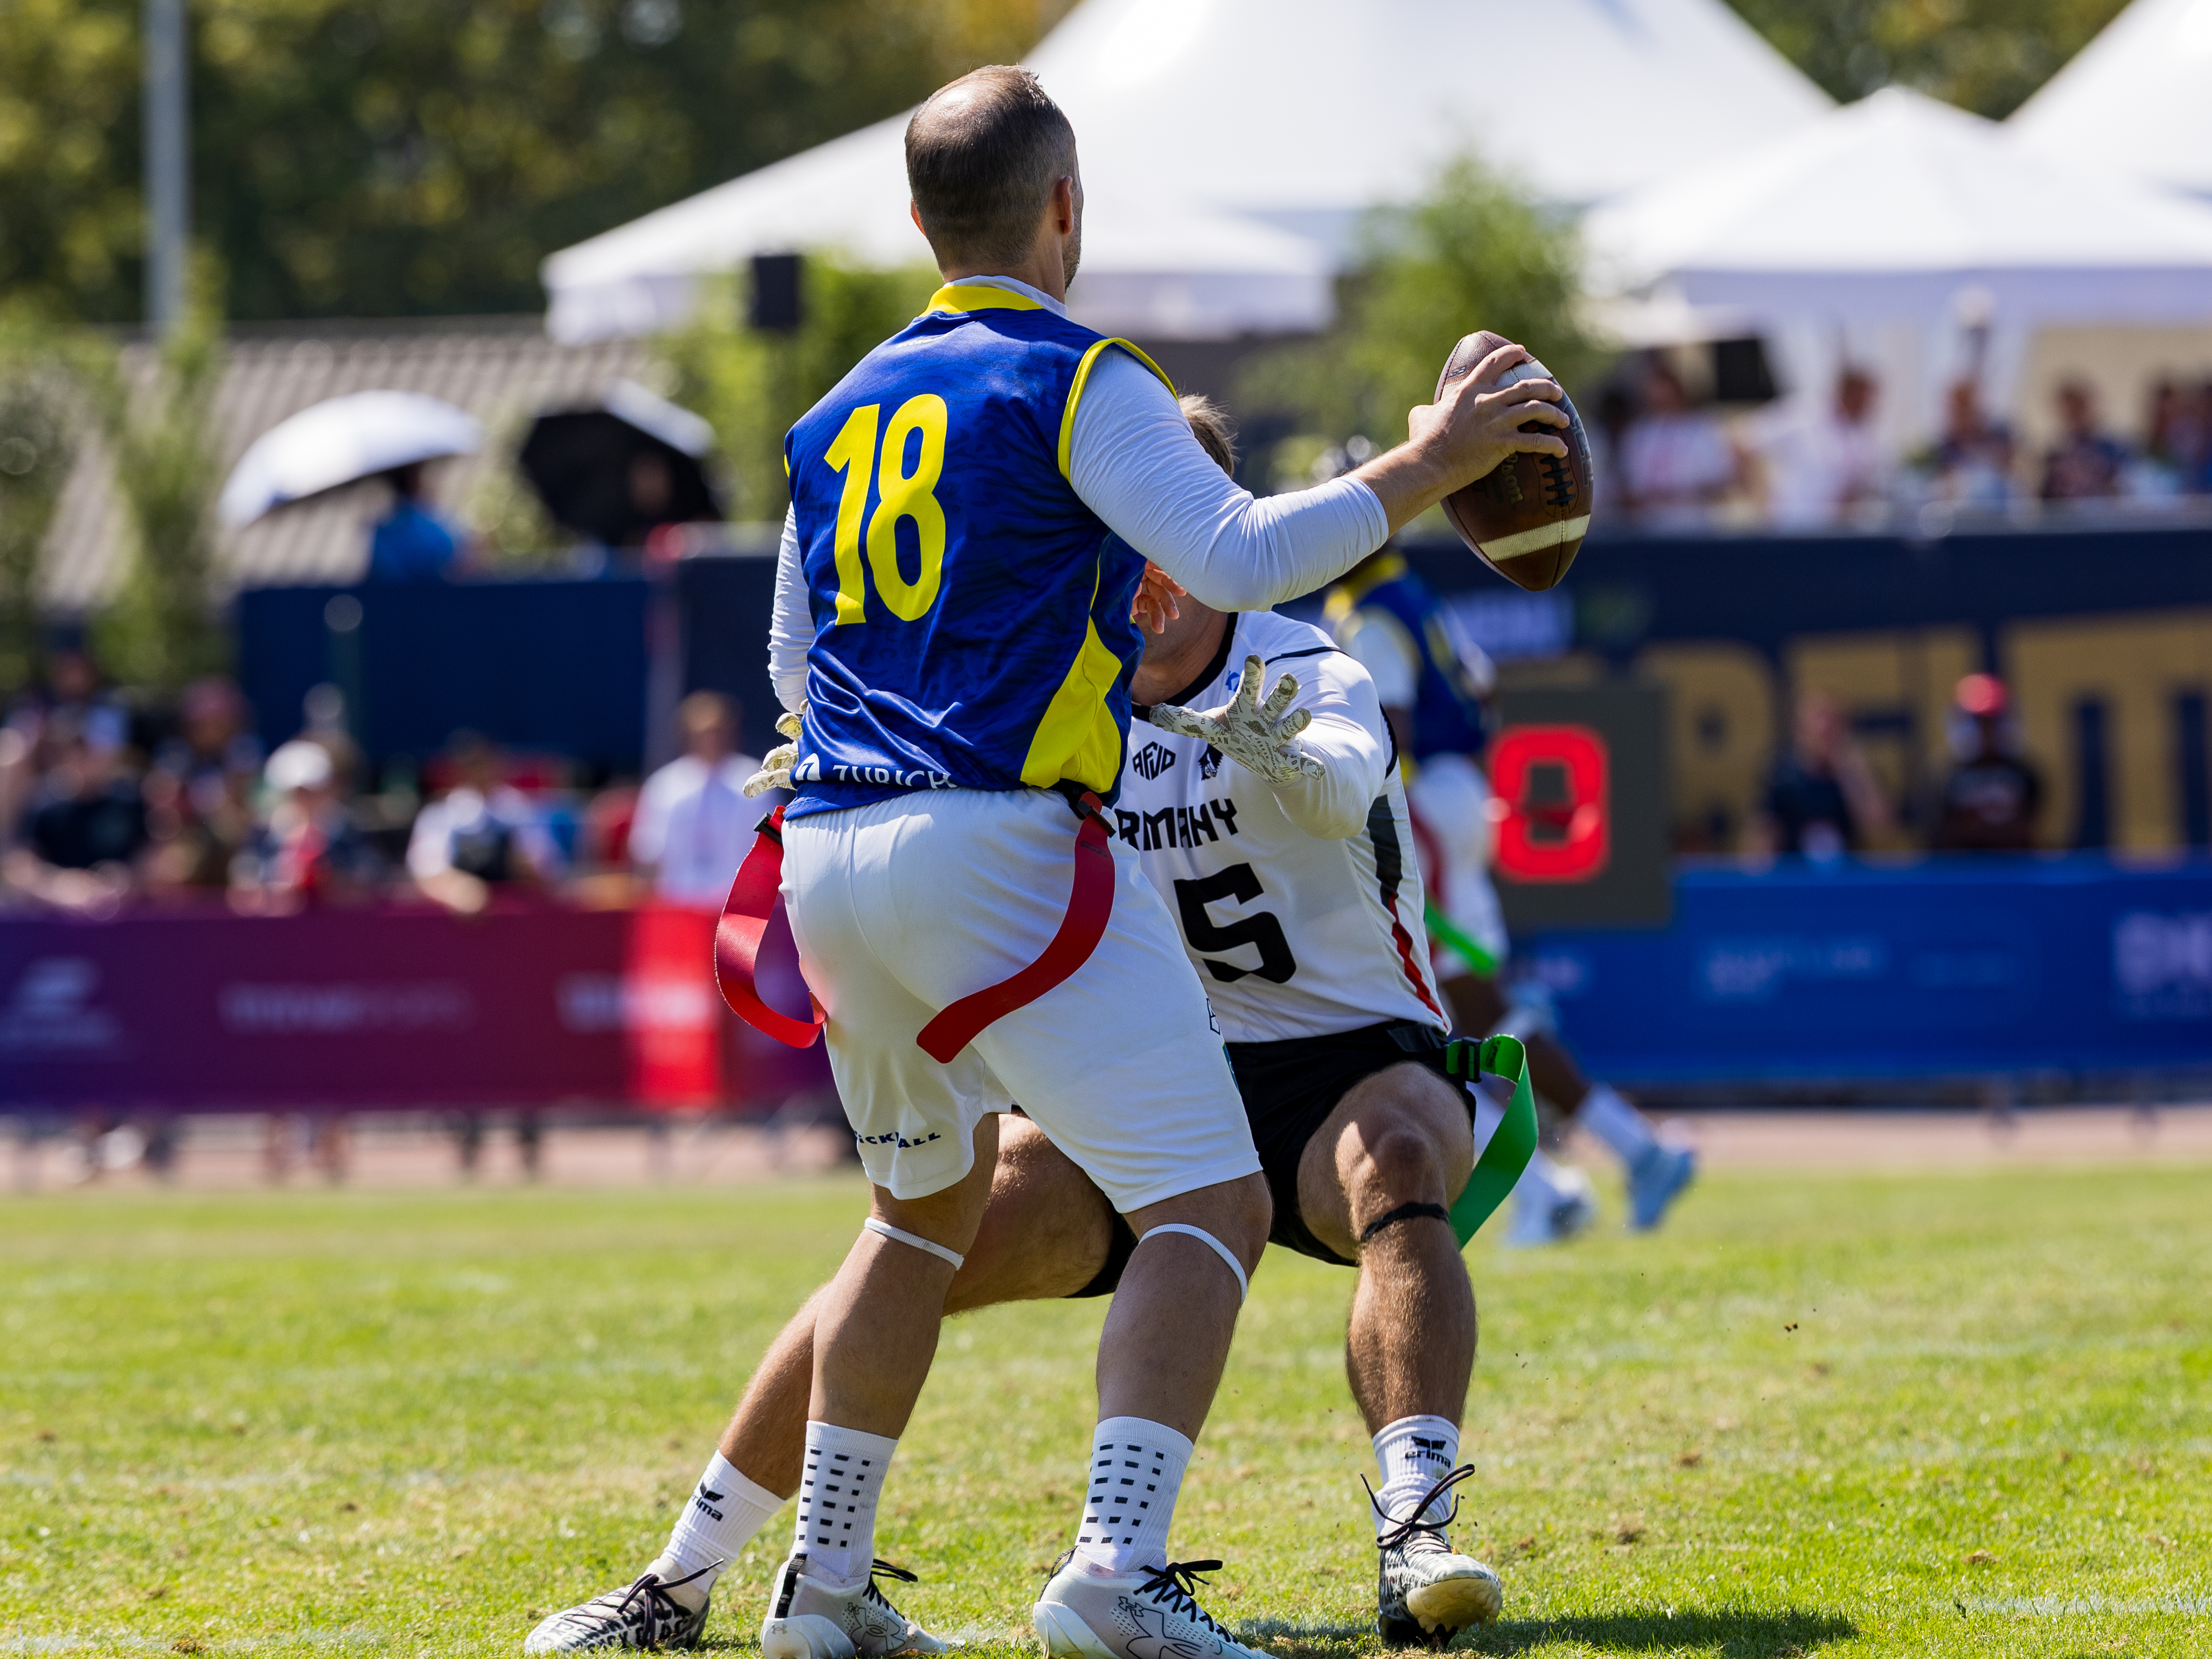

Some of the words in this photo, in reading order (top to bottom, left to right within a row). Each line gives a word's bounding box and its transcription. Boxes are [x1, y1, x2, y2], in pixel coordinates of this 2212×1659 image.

[824, 394, 947, 625] 18
[1114, 798, 1239, 851] RMANY
[1173, 862, 1296, 984] 5
[854, 1130, 941, 1149] ICKALL
[1405, 1448, 1451, 1469] erima
[692, 1494, 724, 1522] rima
